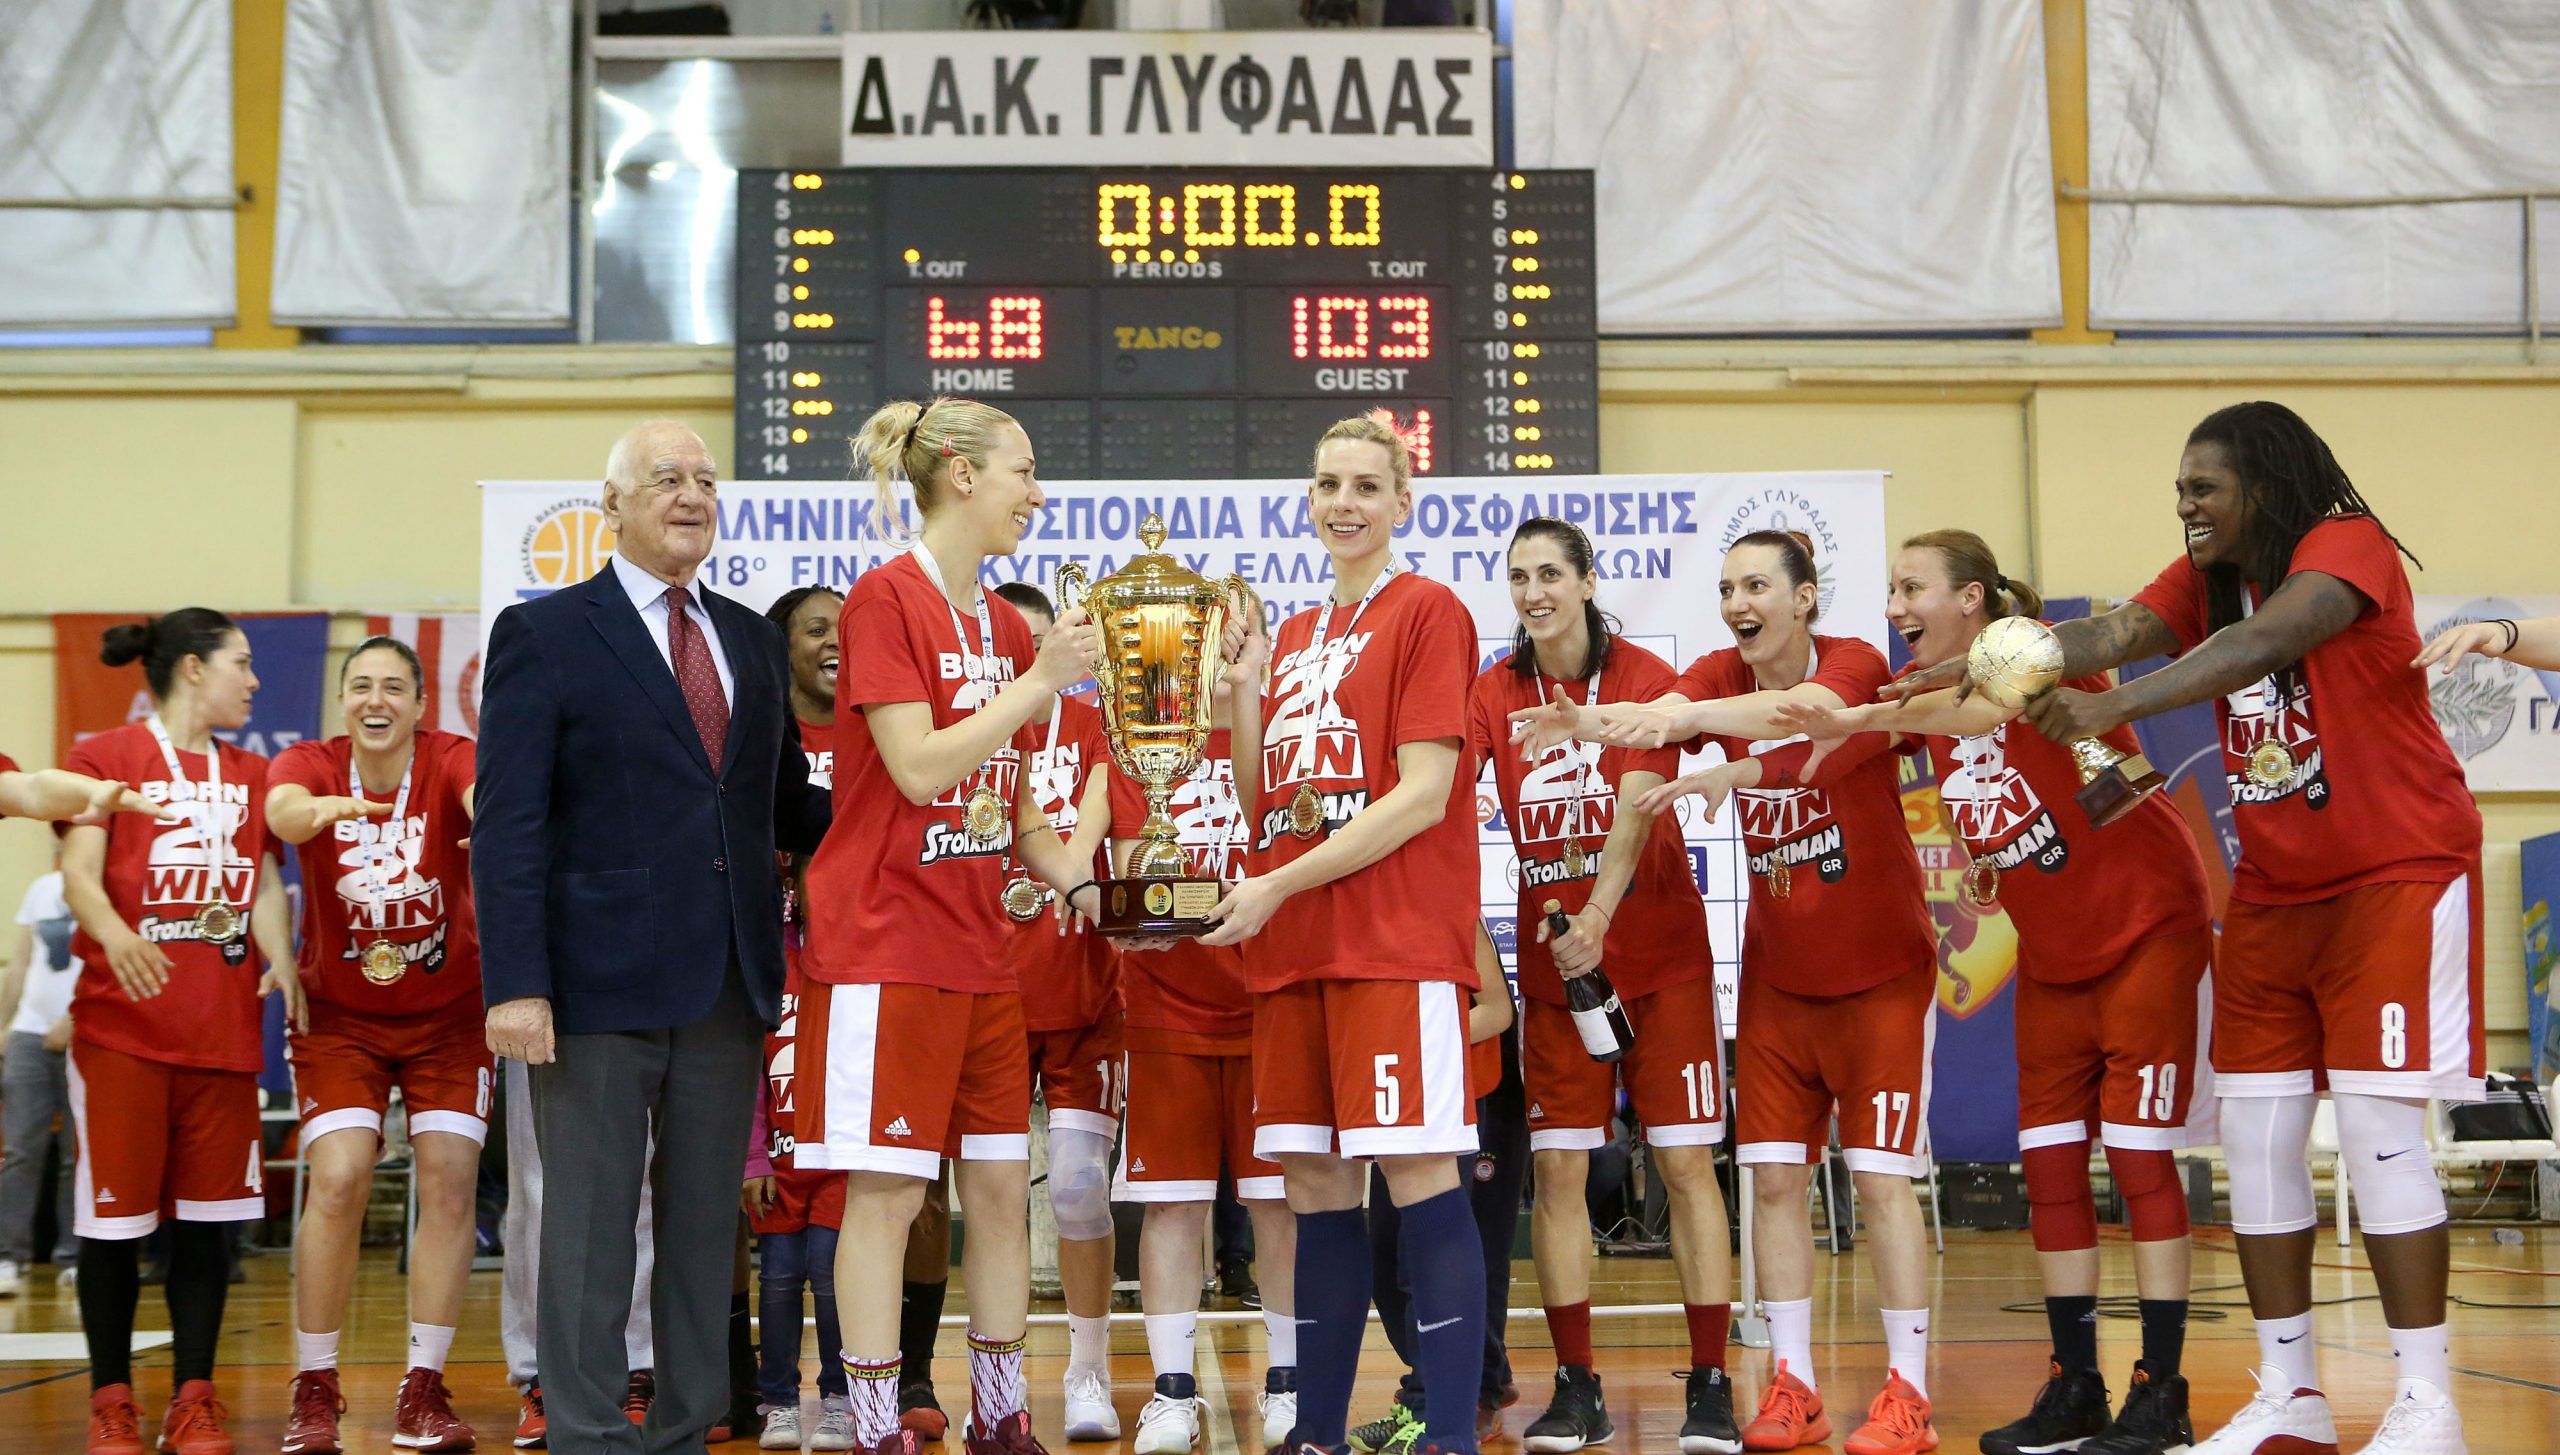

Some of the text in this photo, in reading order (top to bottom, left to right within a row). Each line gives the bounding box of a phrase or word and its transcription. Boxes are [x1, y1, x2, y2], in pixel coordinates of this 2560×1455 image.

[851, 54, 1474, 136] Δ.Α.Κ. ΓΛΥΦΑΔΑΣ
[774, 173, 790, 192] 4
[1490, 173, 1507, 192] 4
[774, 201, 791, 220] 5
[1492, 200, 1507, 220] 5
[774, 228, 790, 247] 6
[1492, 228, 1508, 247] 6
[775, 257, 790, 275] 7
[926, 261, 967, 278] OUT
[1113, 261, 1224, 279] PERIODS
[1387, 261, 1427, 278] OUT
[1493, 255, 1508, 274] 7
[774, 284, 790, 303] 8
[1492, 283, 1509, 302] 8
[774, 312, 791, 331] 9
[928, 296, 1042, 359] 68
[1292, 296, 1430, 359] 103
[1492, 310, 1509, 329] 9
[761, 342, 789, 362] 10
[1483, 341, 1509, 361] 10
[762, 371, 789, 390] 11
[931, 368, 1015, 392] HOME
[1315, 368, 1410, 392] GUEST
[1484, 369, 1509, 388] 11
[761, 399, 789, 418] 12
[1483, 397, 1509, 416] 12
[761, 427, 789, 446] 13
[1484, 424, 1510, 444] 13
[761, 455, 789, 474] 14
[1484, 452, 1511, 471] 14
[535, 498, 604, 524] BASKETBA
[1764, 489, 1839, 554] ΓΛΥΦΑΔΑΣ
[1273, 631, 1374, 677] BORN
[938, 651, 1016, 684] BORN
[140, 780, 249, 805] BORN
[2307, 782, 2326, 800] GR
[1737, 788, 1832, 839] WIN
[334, 811, 428, 846] BORN
[1821, 857, 1843, 873] GR
[2041, 845, 2065, 867] GR
[142, 865, 256, 906] WIN
[223, 944, 245, 957] GR
[427, 949, 443, 967] GR
[2380, 1001, 2406, 1069] 8
[1373, 1053, 1400, 1126] 5
[1681, 1059, 1715, 1120] 10
[2137, 1062, 2177, 1121] 19
[1871, 1090, 1911, 1149] 17
[884, 1127, 912, 1136] adidas
[244, 1139, 263, 1194] 4
